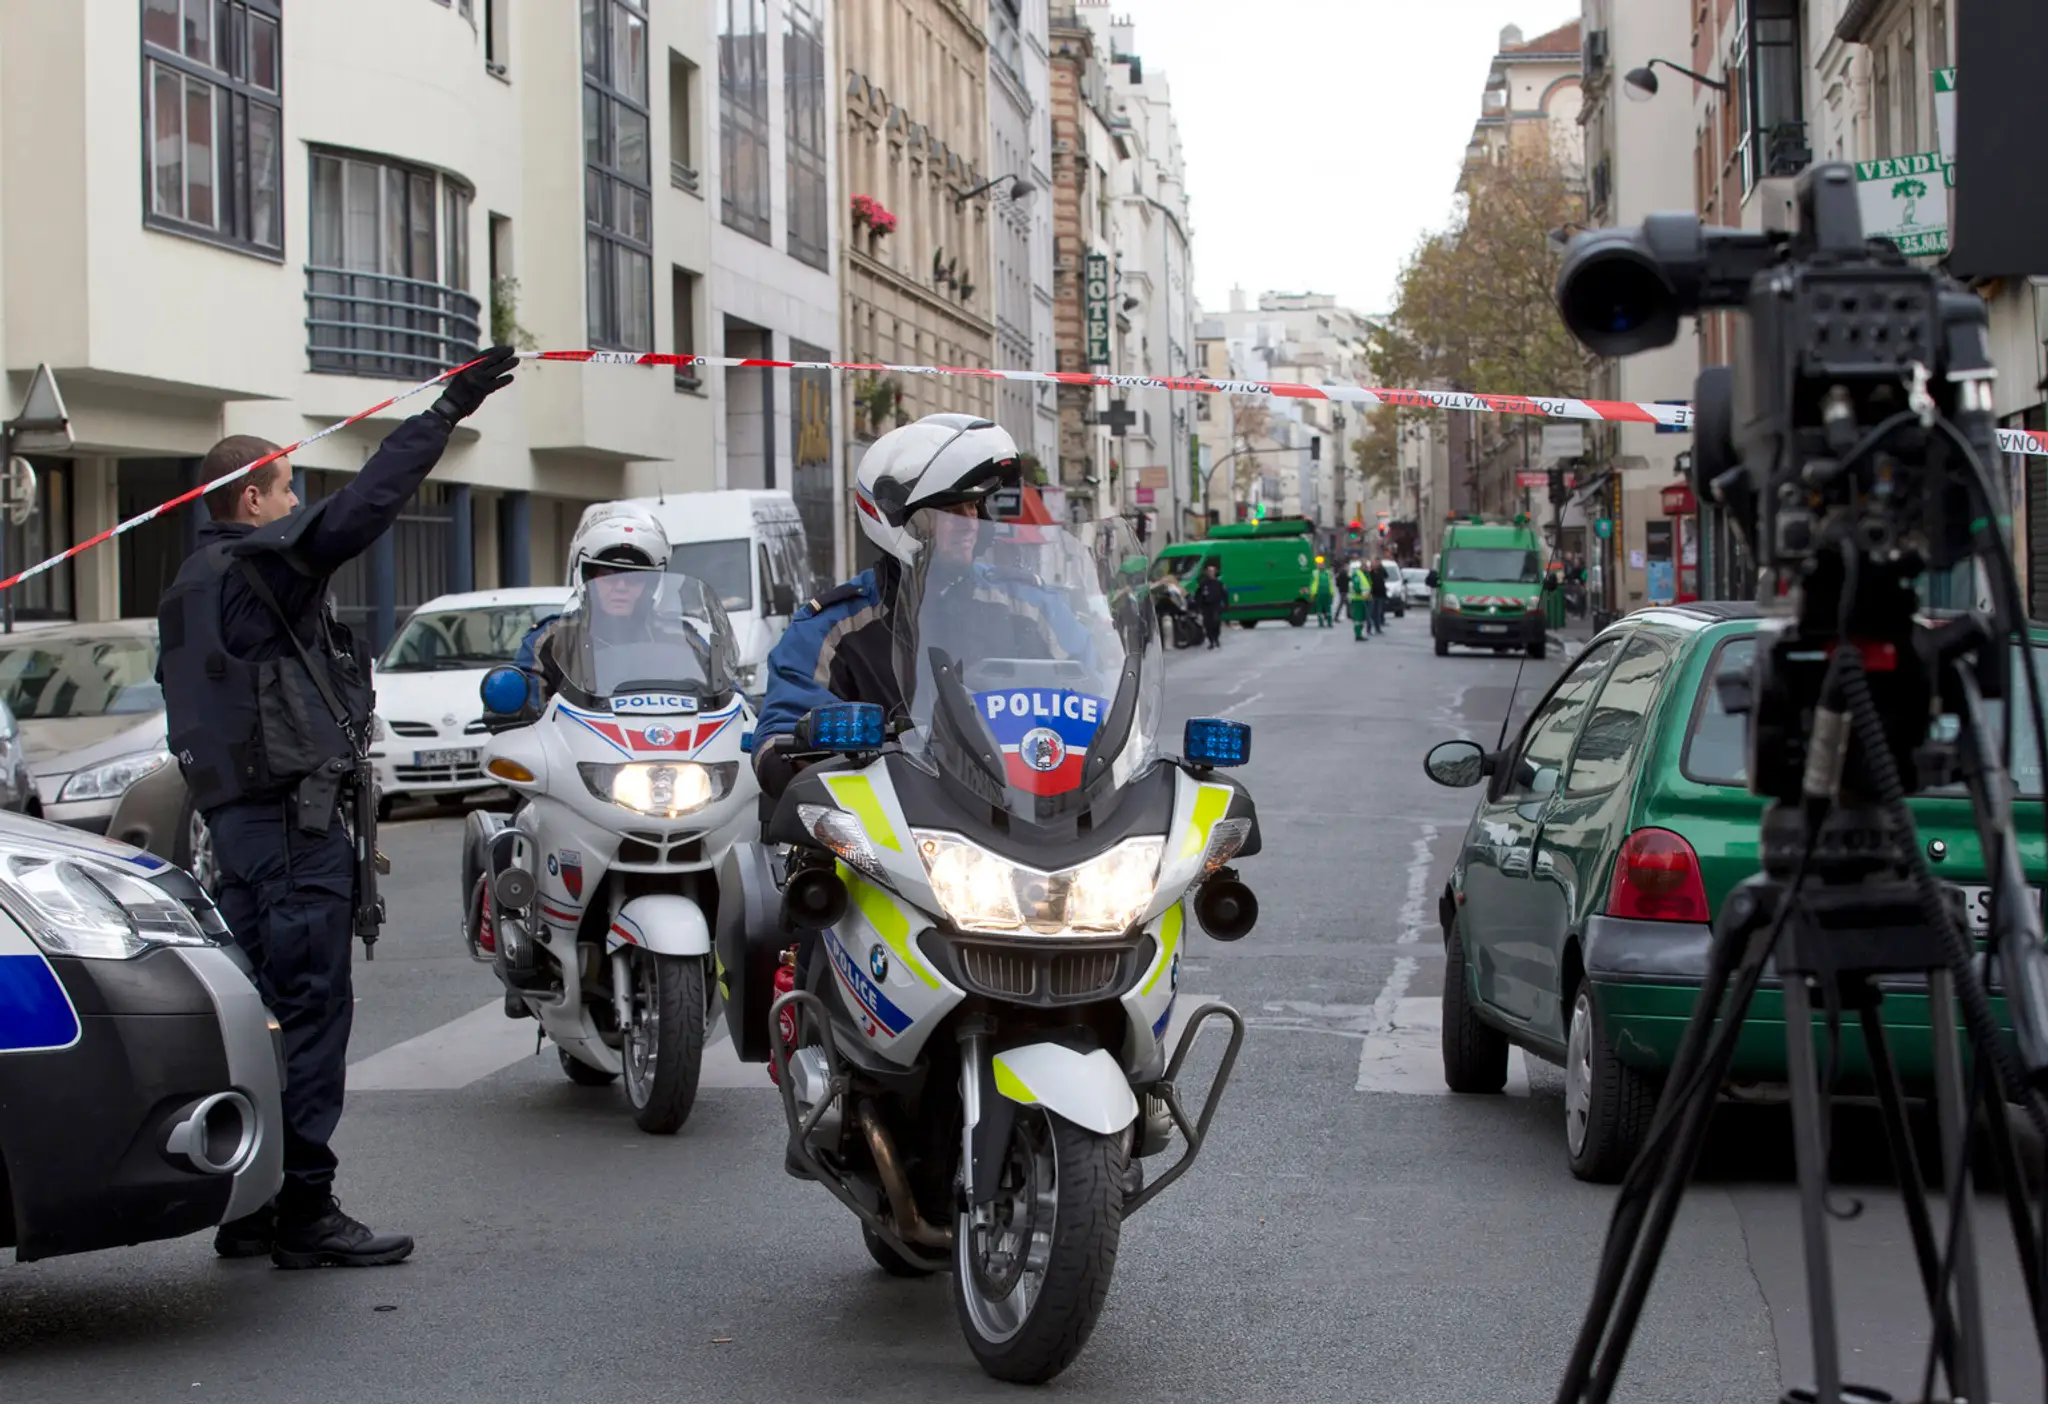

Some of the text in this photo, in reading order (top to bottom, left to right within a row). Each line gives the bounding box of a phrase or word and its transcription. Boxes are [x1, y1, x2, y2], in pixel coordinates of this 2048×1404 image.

[1088, 260, 1108, 360] HOTEL
[1496, 398, 1565, 415] POLICE
[615, 696, 693, 708] POLICE
[987, 693, 1097, 723] POLICE
[833, 939, 877, 1011] POLICE
